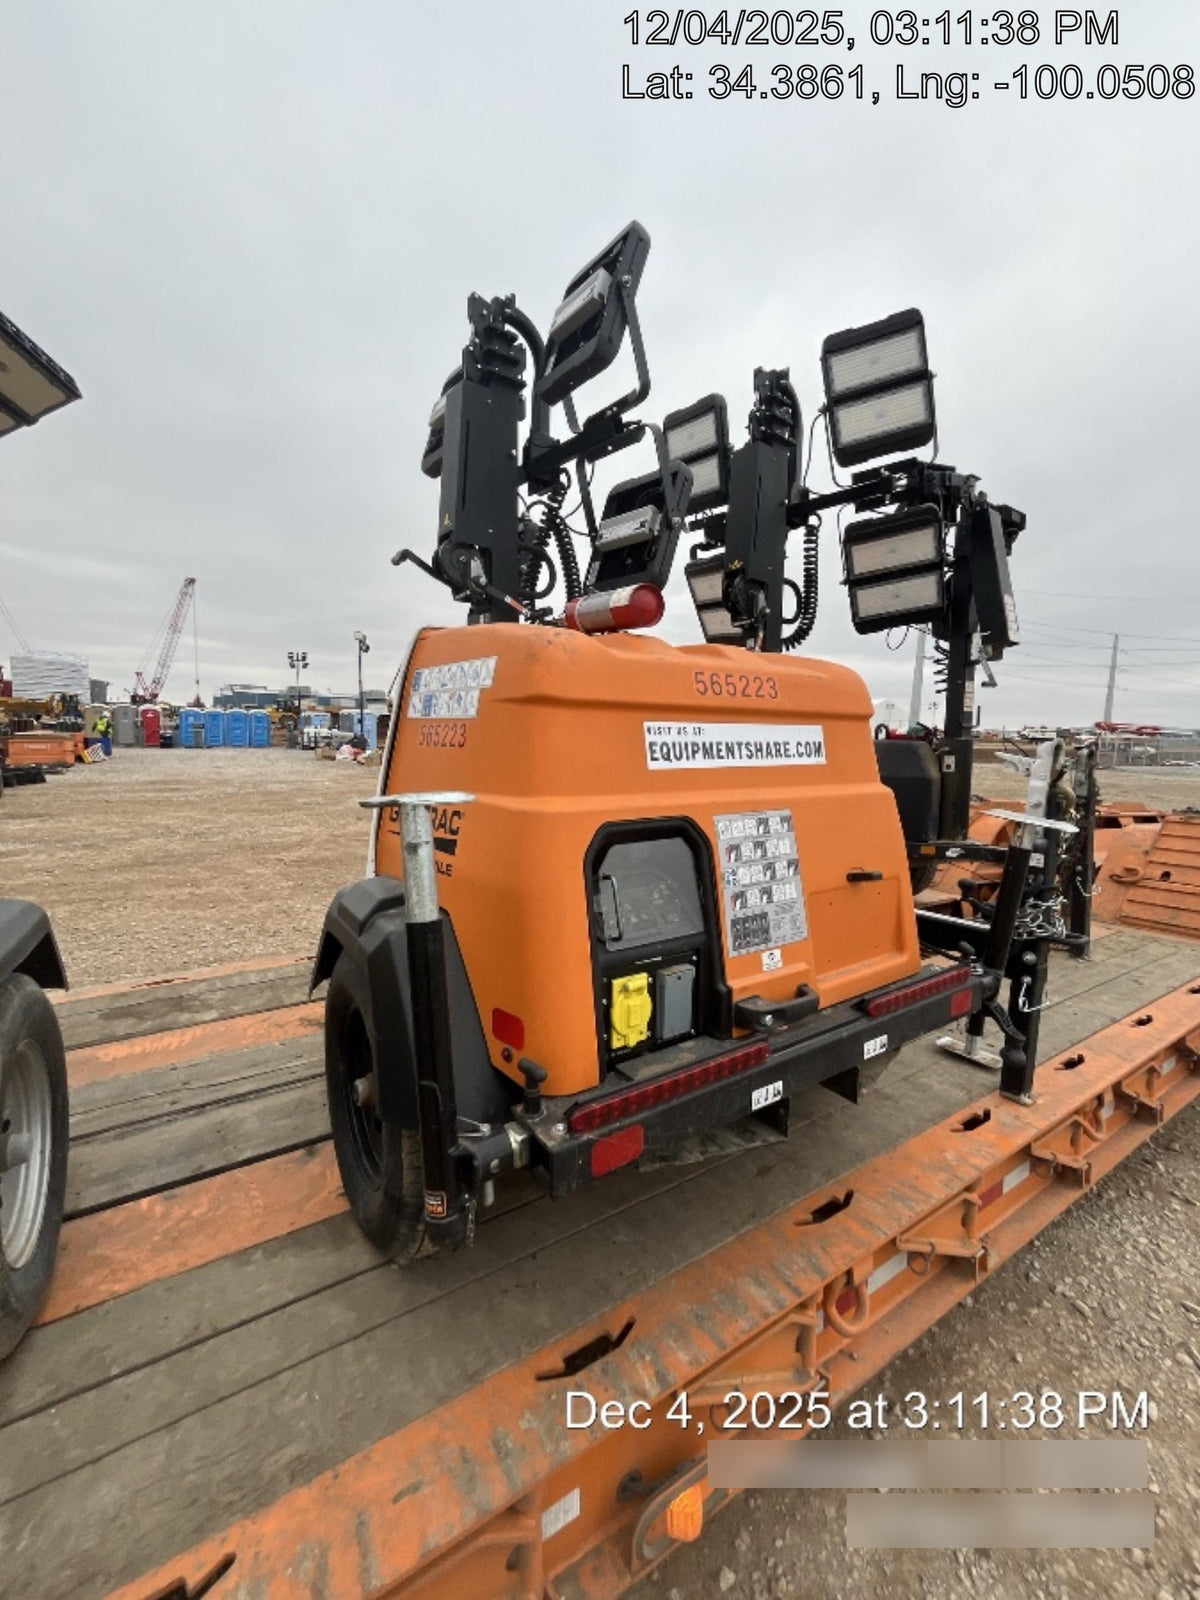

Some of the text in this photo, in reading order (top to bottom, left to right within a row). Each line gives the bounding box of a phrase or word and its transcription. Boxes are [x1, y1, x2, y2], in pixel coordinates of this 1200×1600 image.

[694, 672, 778, 699] 565223
[419, 723, 467, 748] 565223
[648, 740, 823, 763] EQUIPMENTSHARE.COM
[389, 804, 460, 836] GRAC
